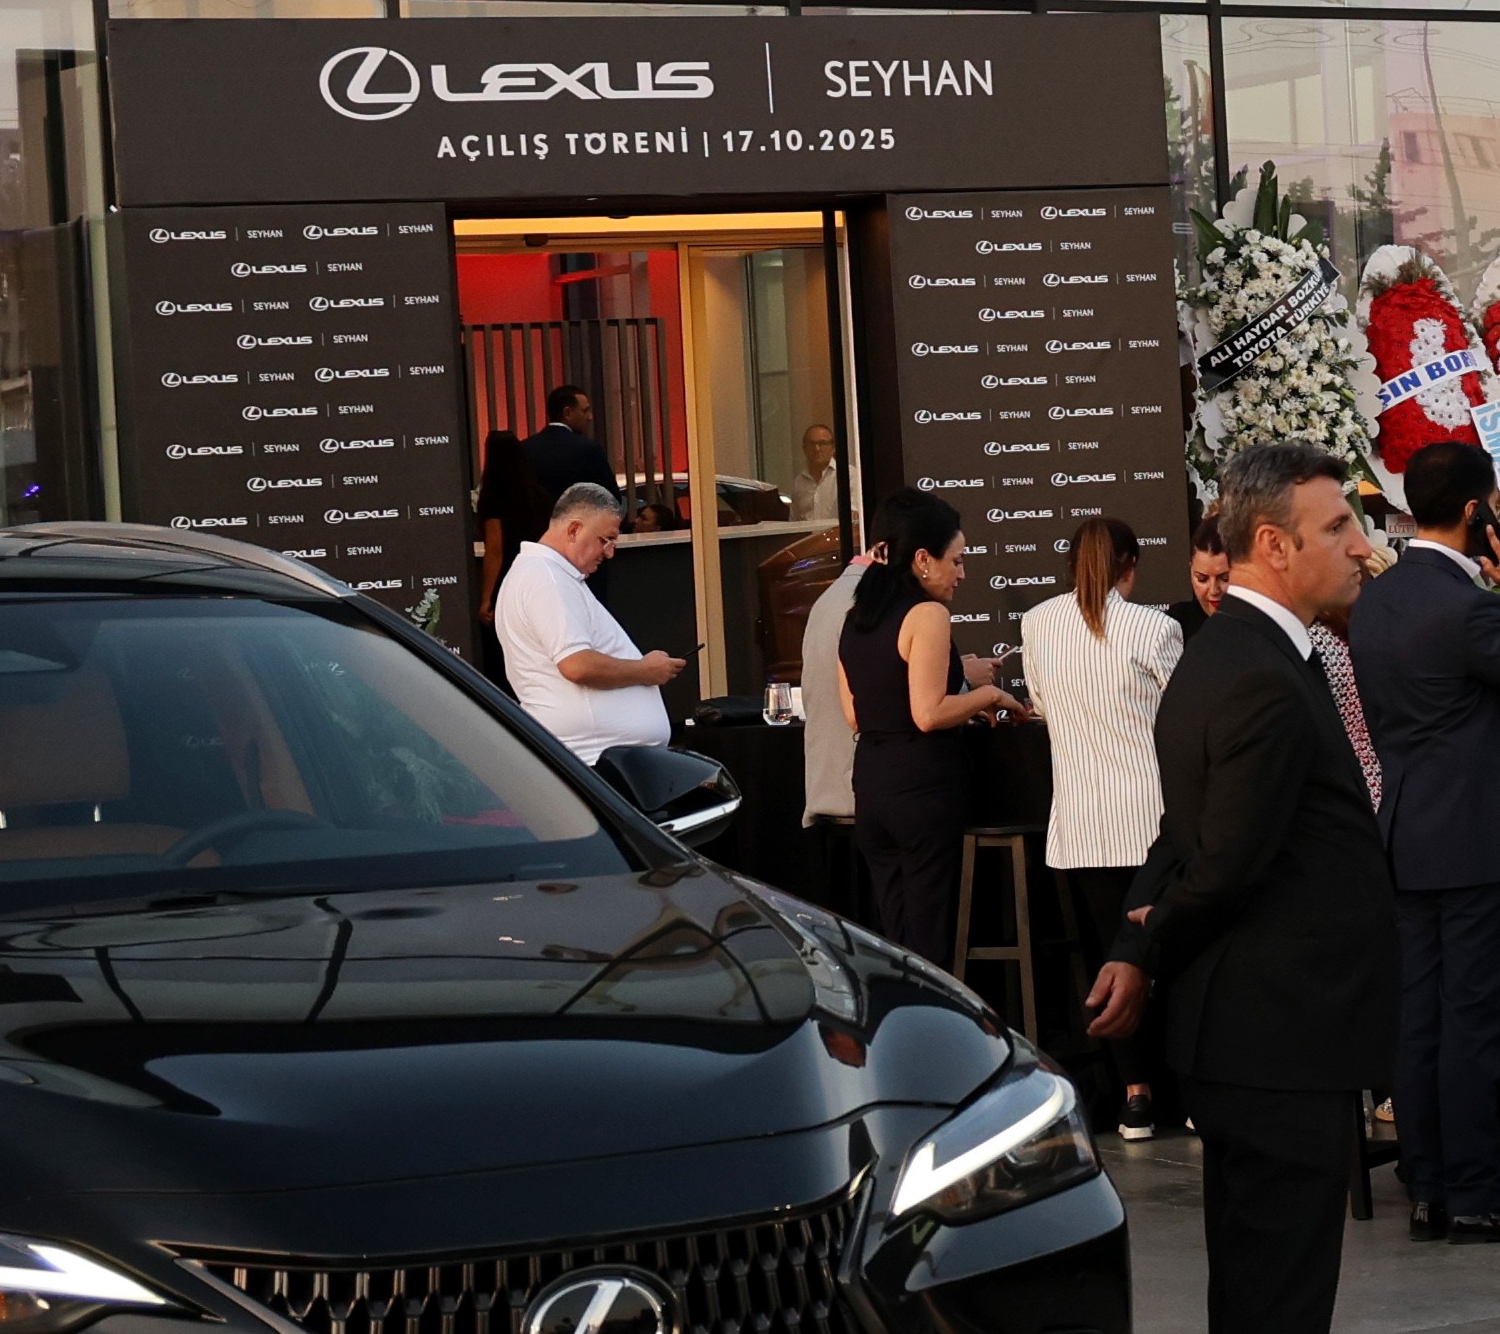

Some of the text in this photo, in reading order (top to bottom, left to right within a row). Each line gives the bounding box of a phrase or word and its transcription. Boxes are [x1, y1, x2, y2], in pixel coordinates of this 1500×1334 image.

[431, 59, 994, 101] LEXUS SEYHAN
[437, 127, 896, 161] AÇILIŞ TÖRENİ 17.10.2025
[923, 209, 1023, 219] LEXUS SEYHAN
[1058, 206, 1155, 217] LEXUS SEYHAN
[170, 229, 283, 240] LEXUS SEYHAN
[323, 223, 434, 237] LEXUS SEYHAN
[993, 242, 1092, 252] LEXUS SEYHAN
[251, 262, 363, 274] LEXUS SEYHAN
[926, 277, 1026, 287] LEXUS SEYHAN
[1060, 273, 1157, 284] LEXUS SEYHAN
[176, 301, 290, 313] LEXUS SEYHAN
[329, 295, 440, 308] LEXUS SEYHAN
[996, 308, 1094, 319] LEXUS SEYHAN
[1231, 282, 1331, 368] TOYOTA TÜRKİYE
[257, 334, 369, 346] LEXUS SEYHAN
[1209, 344, 1234, 367] ALİ
[1233, 304, 1289, 351] HAYDAR
[929, 344, 1028, 354] LEXUS SEYHAN
[1063, 339, 1160, 351] LEXUS SEYHAN
[182, 372, 295, 384] LEXUS SEYHAN
[334, 365, 445, 379] LEXUS SEYHAN
[999, 375, 1097, 386] LEXUS SEYHAN
[262, 404, 374, 418] LEXUS SEYHAN
[932, 410, 1031, 421] LEXUS SEYHAN
[1065, 405, 1162, 417] LEXUS SEYHAN
[339, 435, 449, 450] LEXUS SEYHAN
[1002, 441, 1099, 453] LEXUS SEYHAN
[187, 443, 300, 456] LEXUS SEYHAN
[267, 475, 379, 489] LEXUS SEYHAN
[935, 477, 1034, 488] LEXUS SEYHAN
[1068, 471, 1165, 484] LEXUS SEYHAN
[344, 506, 454, 520] LEXUS SEYHAN
[1004, 507, 1102, 520] LEXUS SEYHAN
[191, 514, 305, 528] LEXUS SEYHAN
[282, 545, 383, 559] EXUS SEYHAN
[1004, 543, 1037, 553] SEYHAN
[422, 576, 458, 586] SEYHAN
[1007, 575, 1057, 586] LEXUS
[950, 613, 991, 623] EXUS
